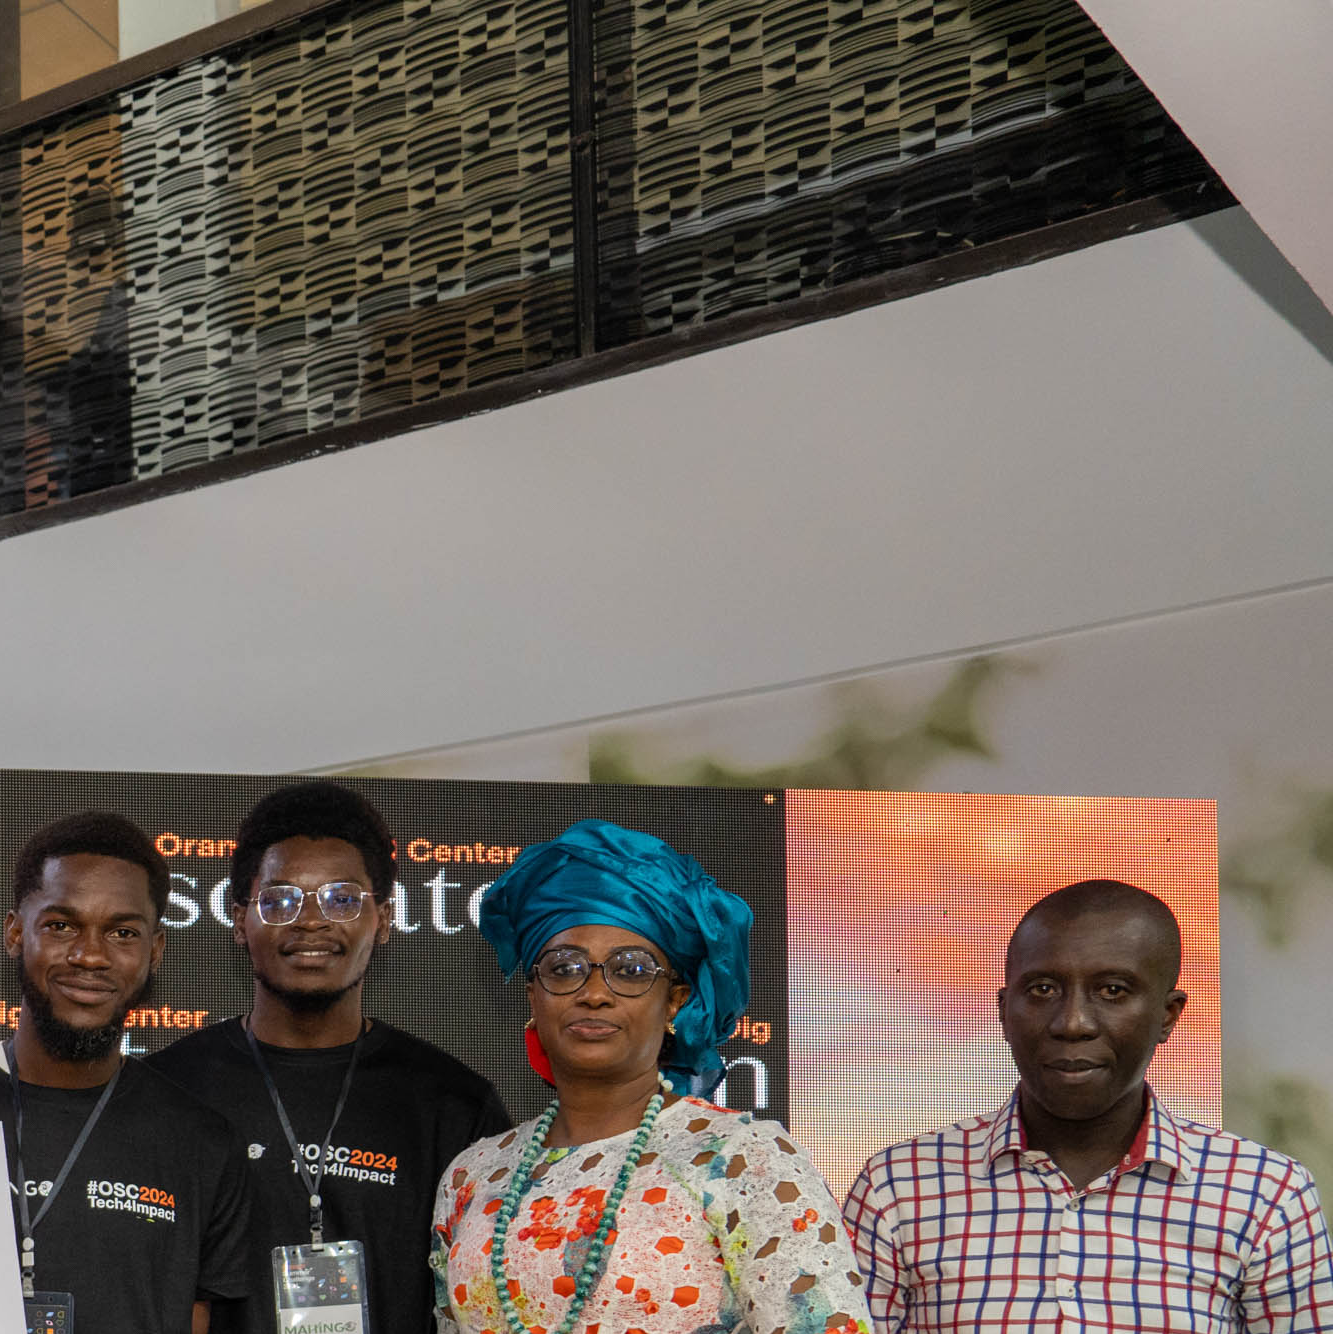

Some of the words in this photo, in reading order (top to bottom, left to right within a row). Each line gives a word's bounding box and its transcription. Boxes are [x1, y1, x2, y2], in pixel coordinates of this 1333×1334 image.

[155, 832, 237, 857] Oran
[407, 838, 522, 865] Center
[124, 1003, 209, 1030] enter
[291, 1160, 397, 1186] Tc4Impact
[87, 1180, 175, 1209] #OSC2024
[87, 1195, 176, 1223] Tech4Impact
